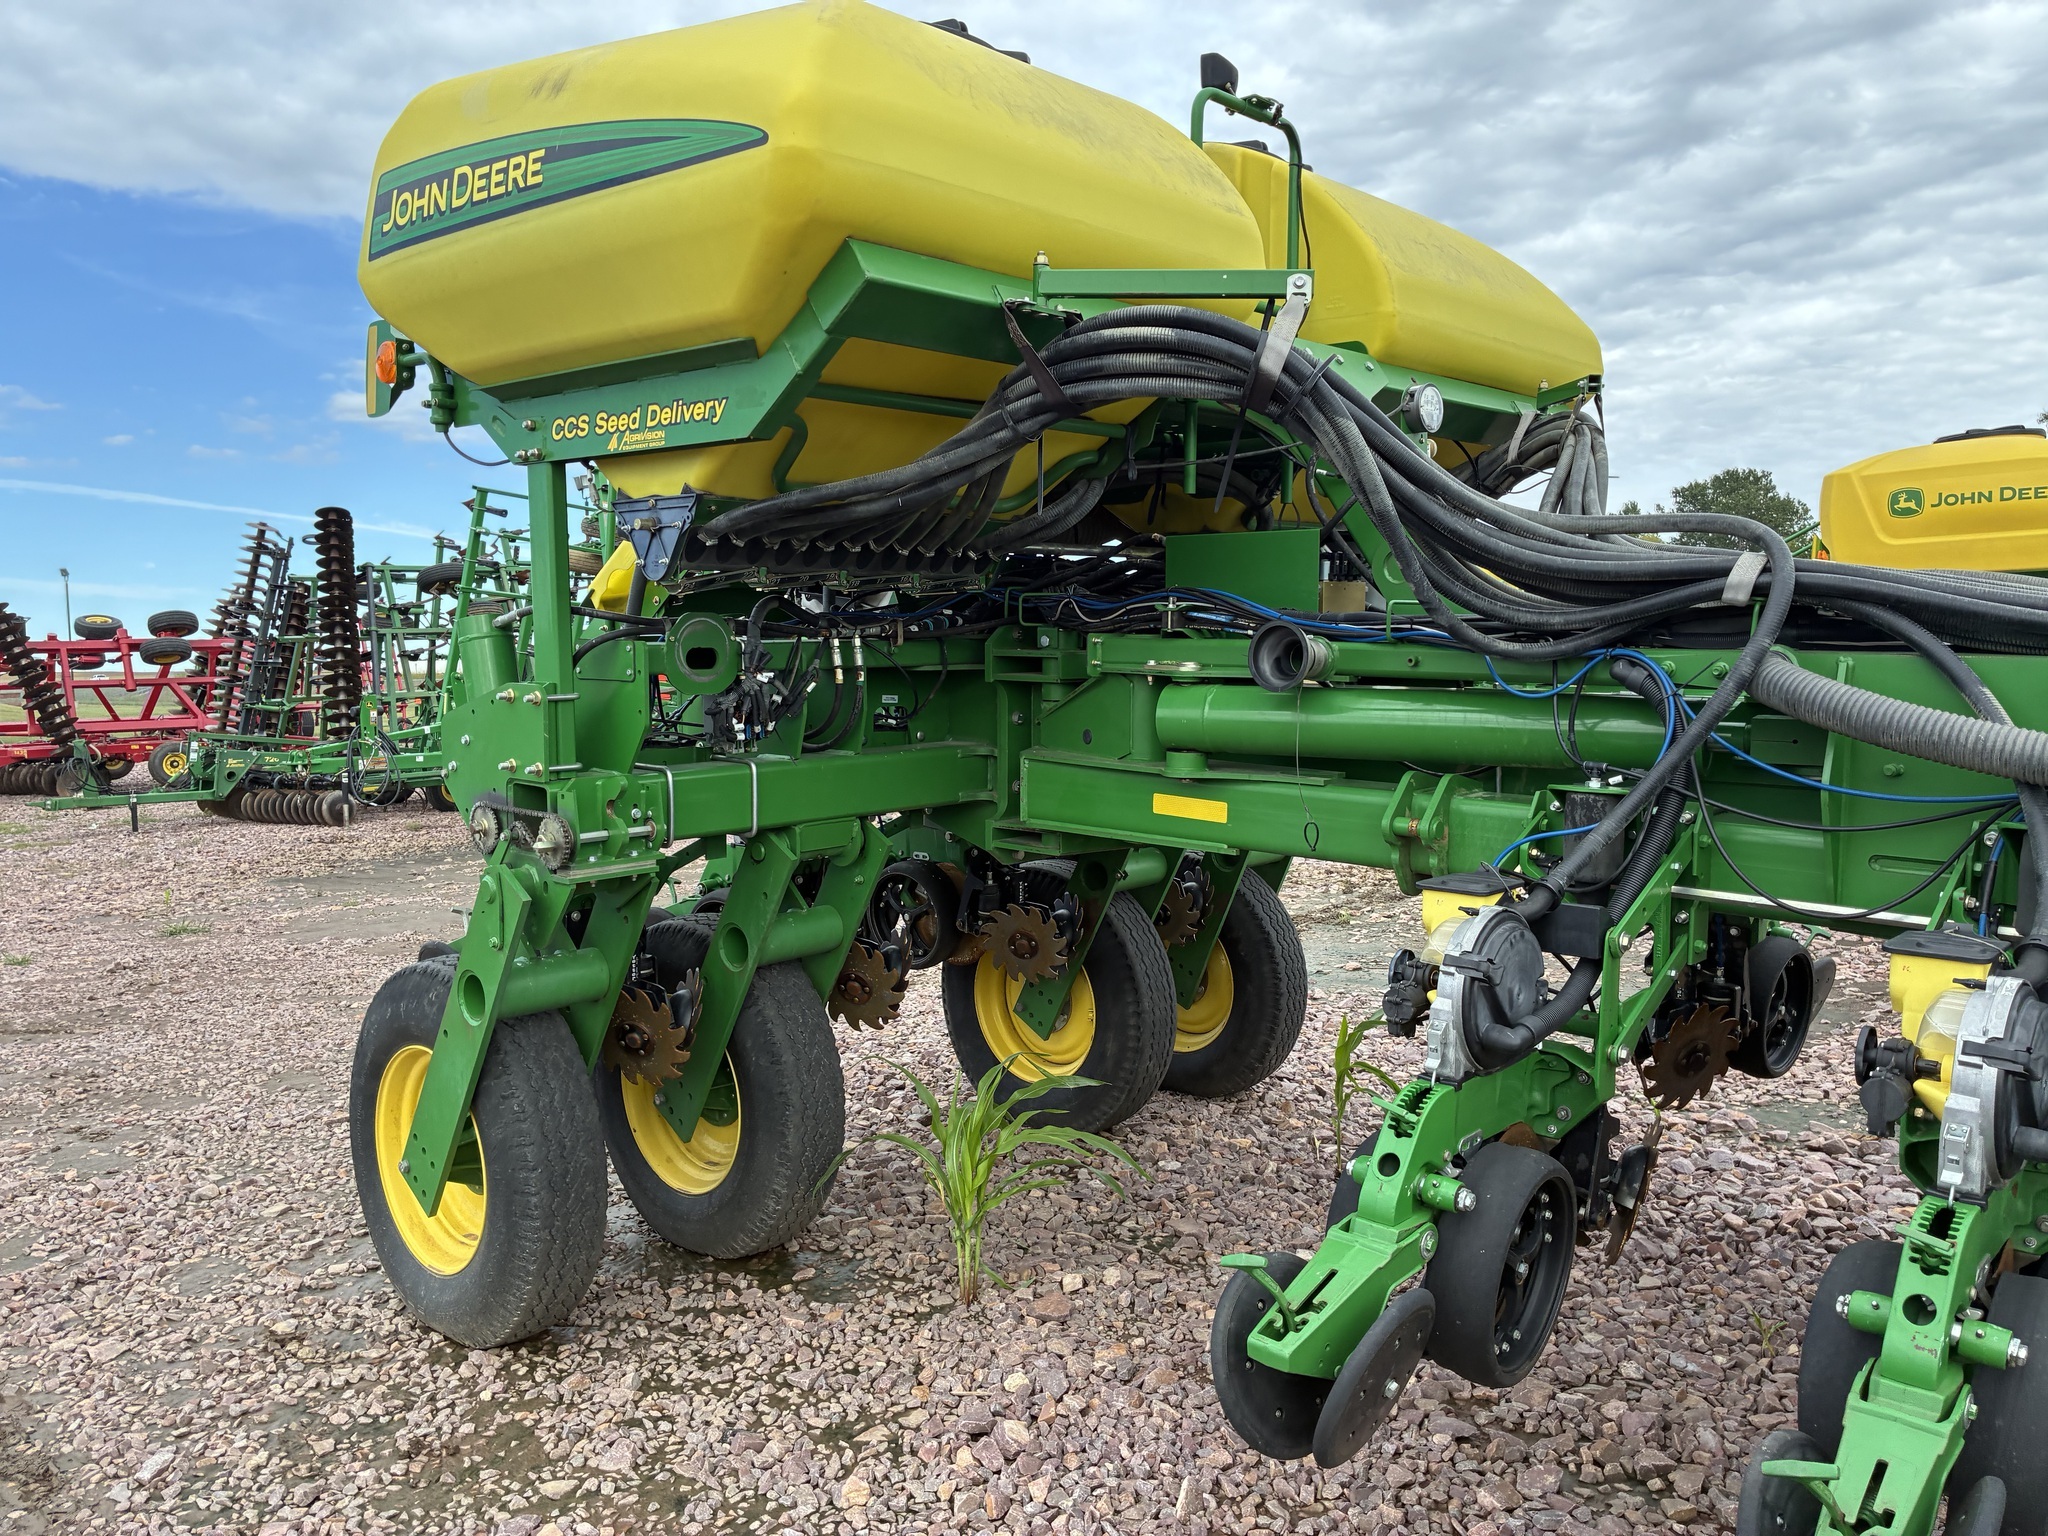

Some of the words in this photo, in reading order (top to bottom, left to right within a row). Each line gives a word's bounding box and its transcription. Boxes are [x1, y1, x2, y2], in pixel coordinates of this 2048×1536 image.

[382, 178, 449, 233] JOHN
[451, 148, 546, 210] DEERE
[552, 414, 590, 441] CCS
[594, 405, 642, 435] Seed
[646, 397, 729, 428] Delivery
[1931, 491, 1993, 508] JOHN
